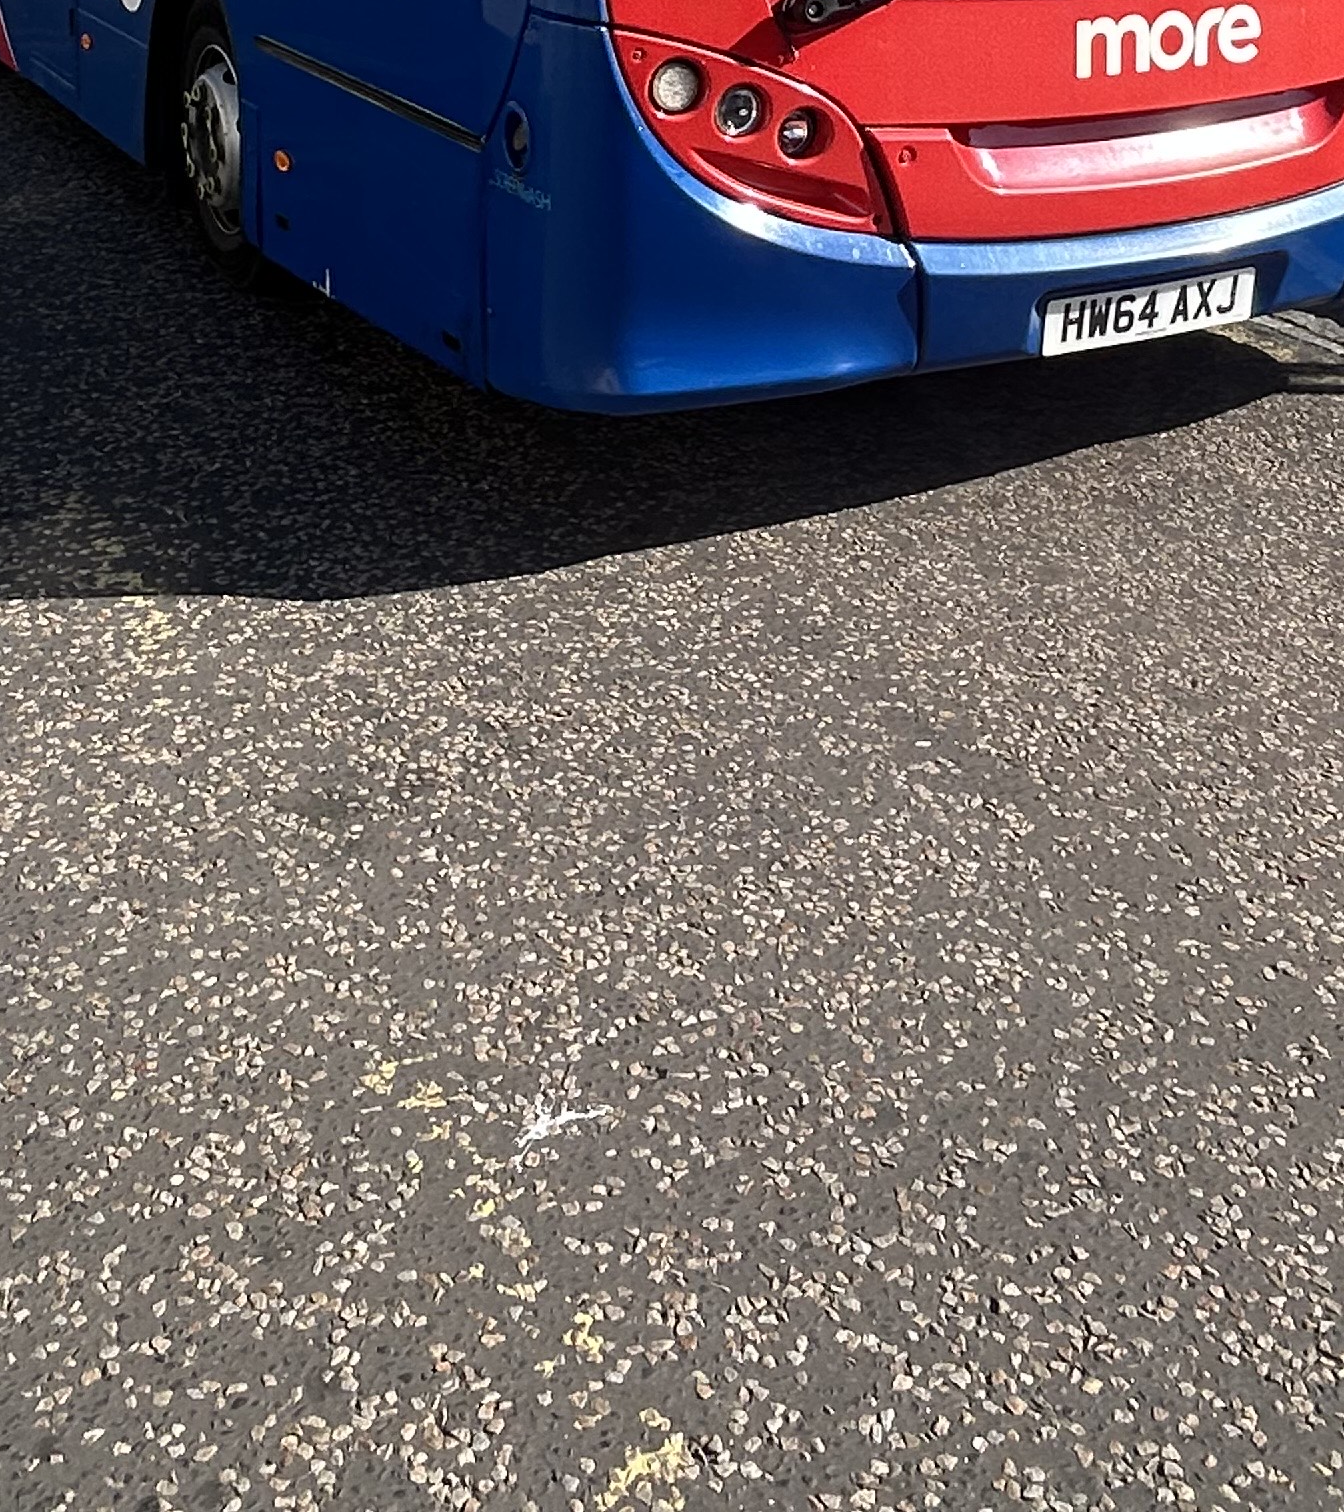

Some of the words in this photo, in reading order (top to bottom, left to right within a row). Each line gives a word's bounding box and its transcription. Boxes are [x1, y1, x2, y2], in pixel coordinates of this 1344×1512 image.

[1076, 3, 1263, 79] more
[1061, 289, 1159, 343] HW64
[1170, 274, 1239, 325] AXJ
